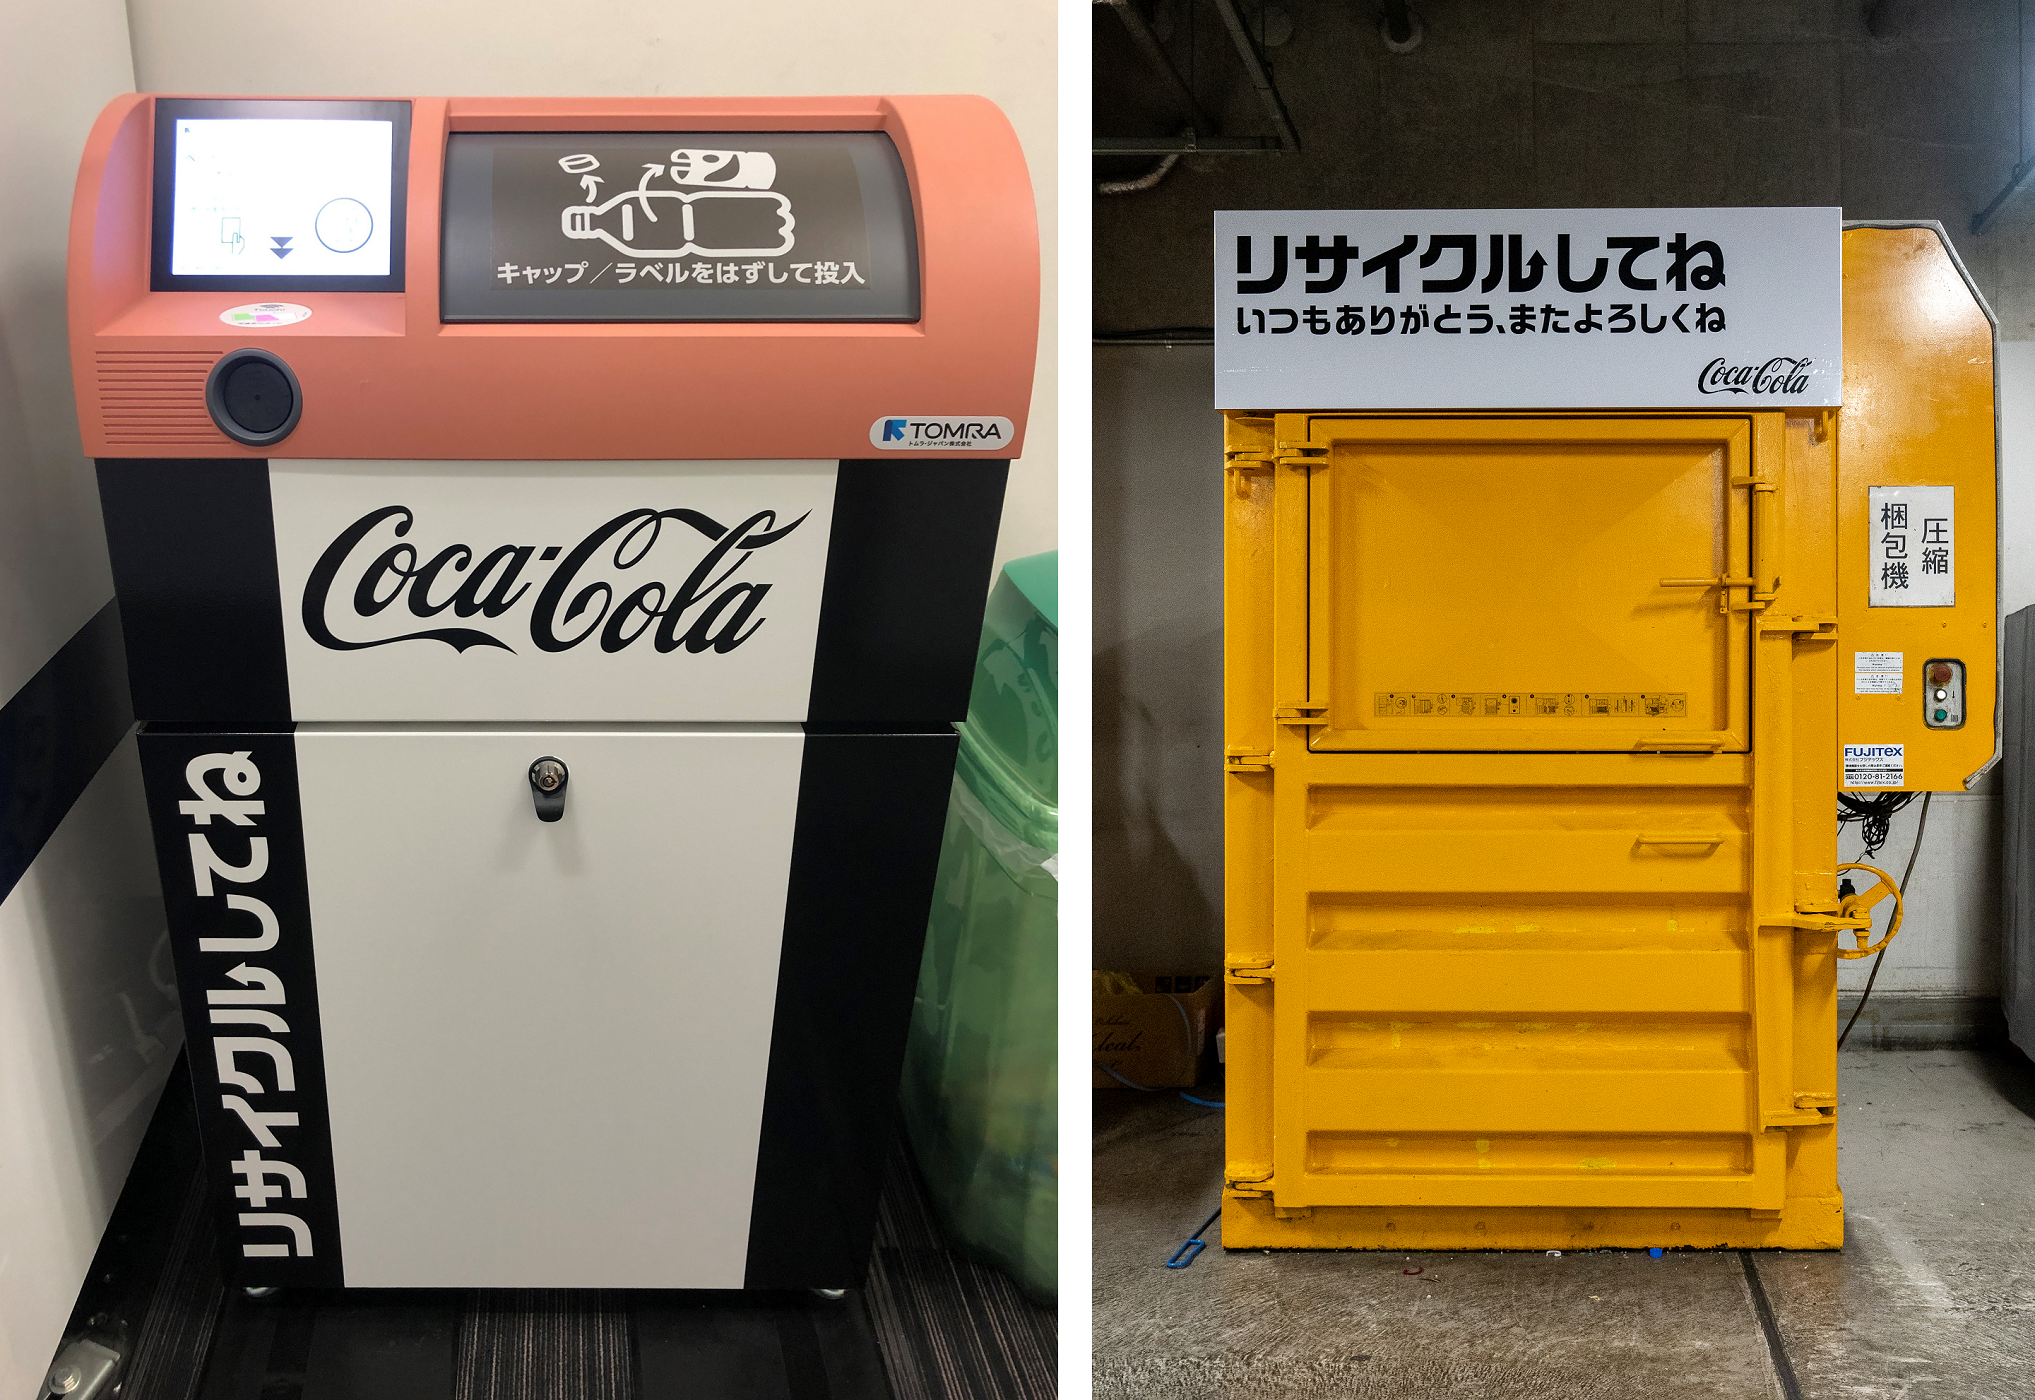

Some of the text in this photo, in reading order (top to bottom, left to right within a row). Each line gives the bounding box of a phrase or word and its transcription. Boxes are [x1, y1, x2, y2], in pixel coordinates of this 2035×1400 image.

[497, 260, 866, 286] キャップ／ラベルをはずして投入
[1237, 232, 1726, 294] リサイクルしてね
[1237, 302, 1726, 336] いつもありがとう、またよろしくね
[1698, 357, 1812, 395] Coca-Cola
[910, 422, 1002, 440] TOMRA
[1880, 502, 1909, 590] 梱包機
[1921, 518, 1949, 575] 圧縮
[301, 505, 813, 656] Coca-Cola
[178, 750, 314, 1258] リサイクルしてね
